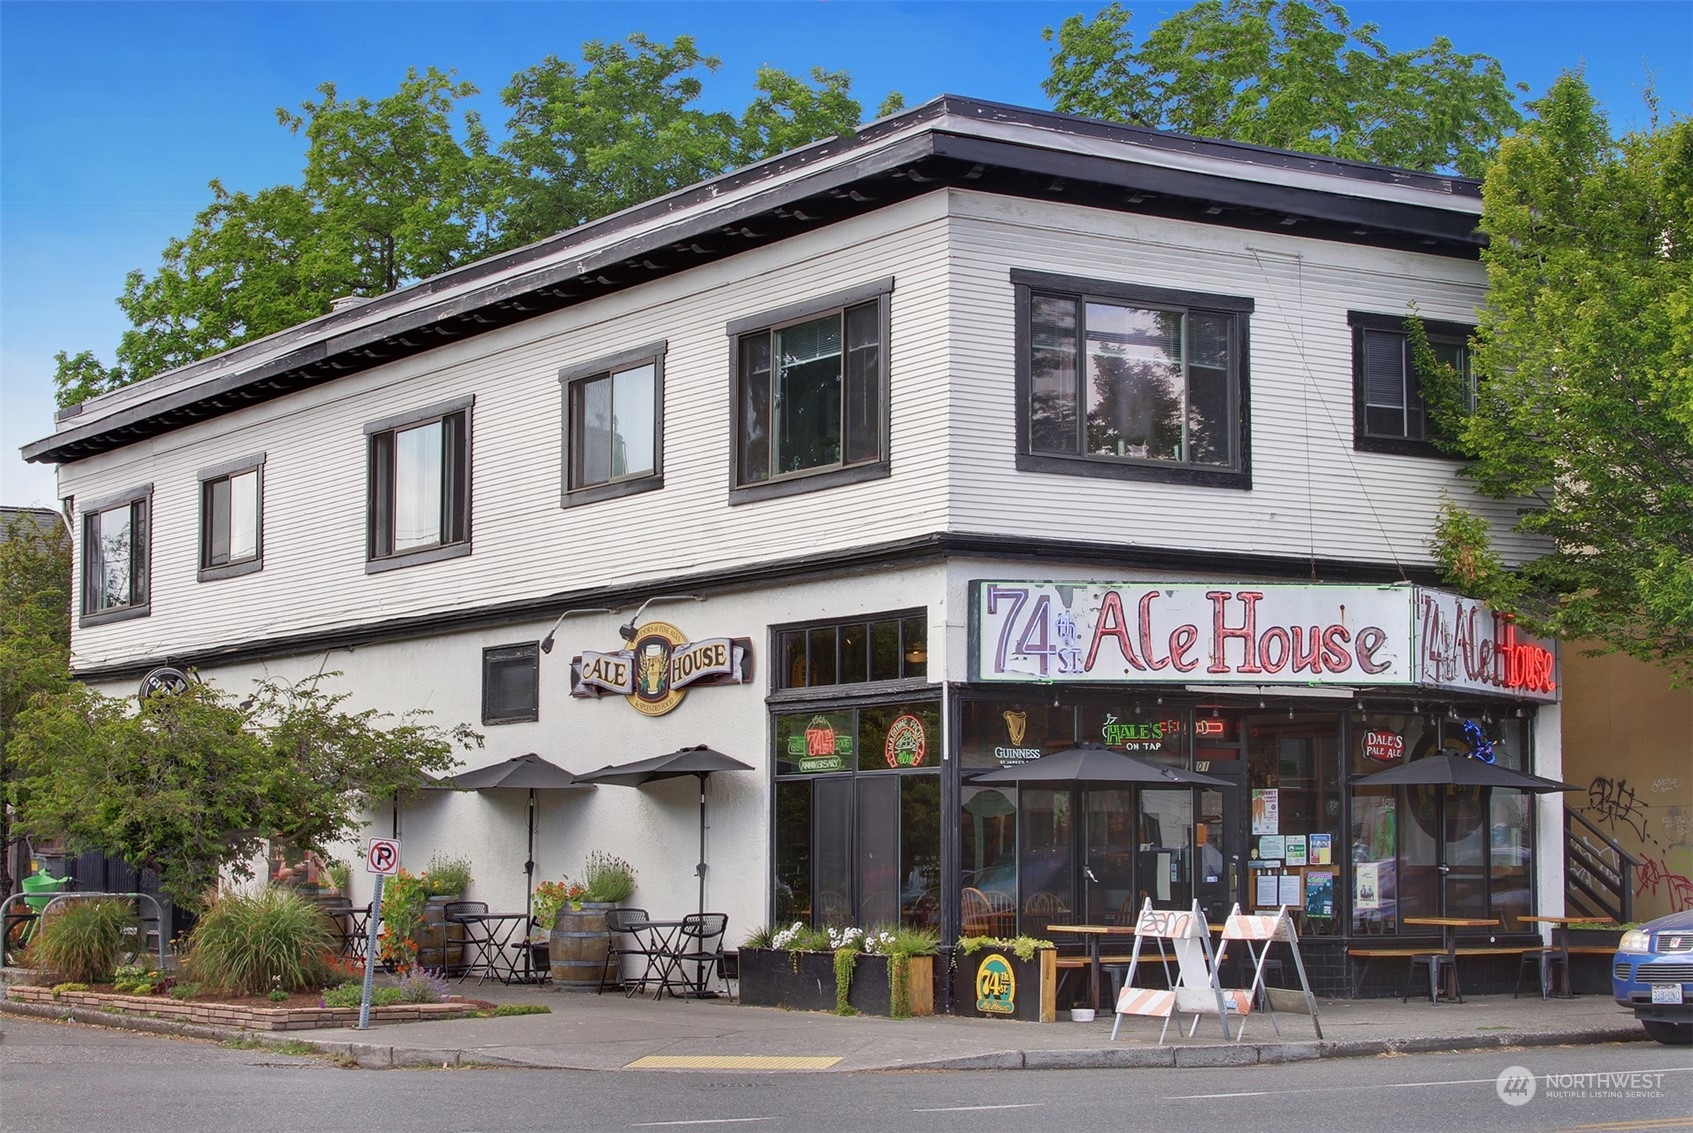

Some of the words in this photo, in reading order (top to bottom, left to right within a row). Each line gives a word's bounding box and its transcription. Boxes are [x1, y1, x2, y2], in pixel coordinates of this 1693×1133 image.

[987, 584, 1056, 677] 74
[1056, 610, 1077, 640] th
[1085, 590, 1198, 673] Ale
[1206, 591, 1391, 674] House
[1491, 609, 1556, 694] House
[583, 657, 627, 687] ALE
[671, 644, 727, 683] HOUSE
[1105, 722, 1164, 746] HALE'S
[1126, 742, 1140, 751] ON
[1142, 742, 1161, 751] TAP
[1367, 732, 1403, 748] DALE'S
[994, 746, 1041, 759] GUINNESS
[1366, 746, 1384, 756] PALE
[1387, 747, 1402, 758] ALE
[982, 969, 1001, 996] 74
